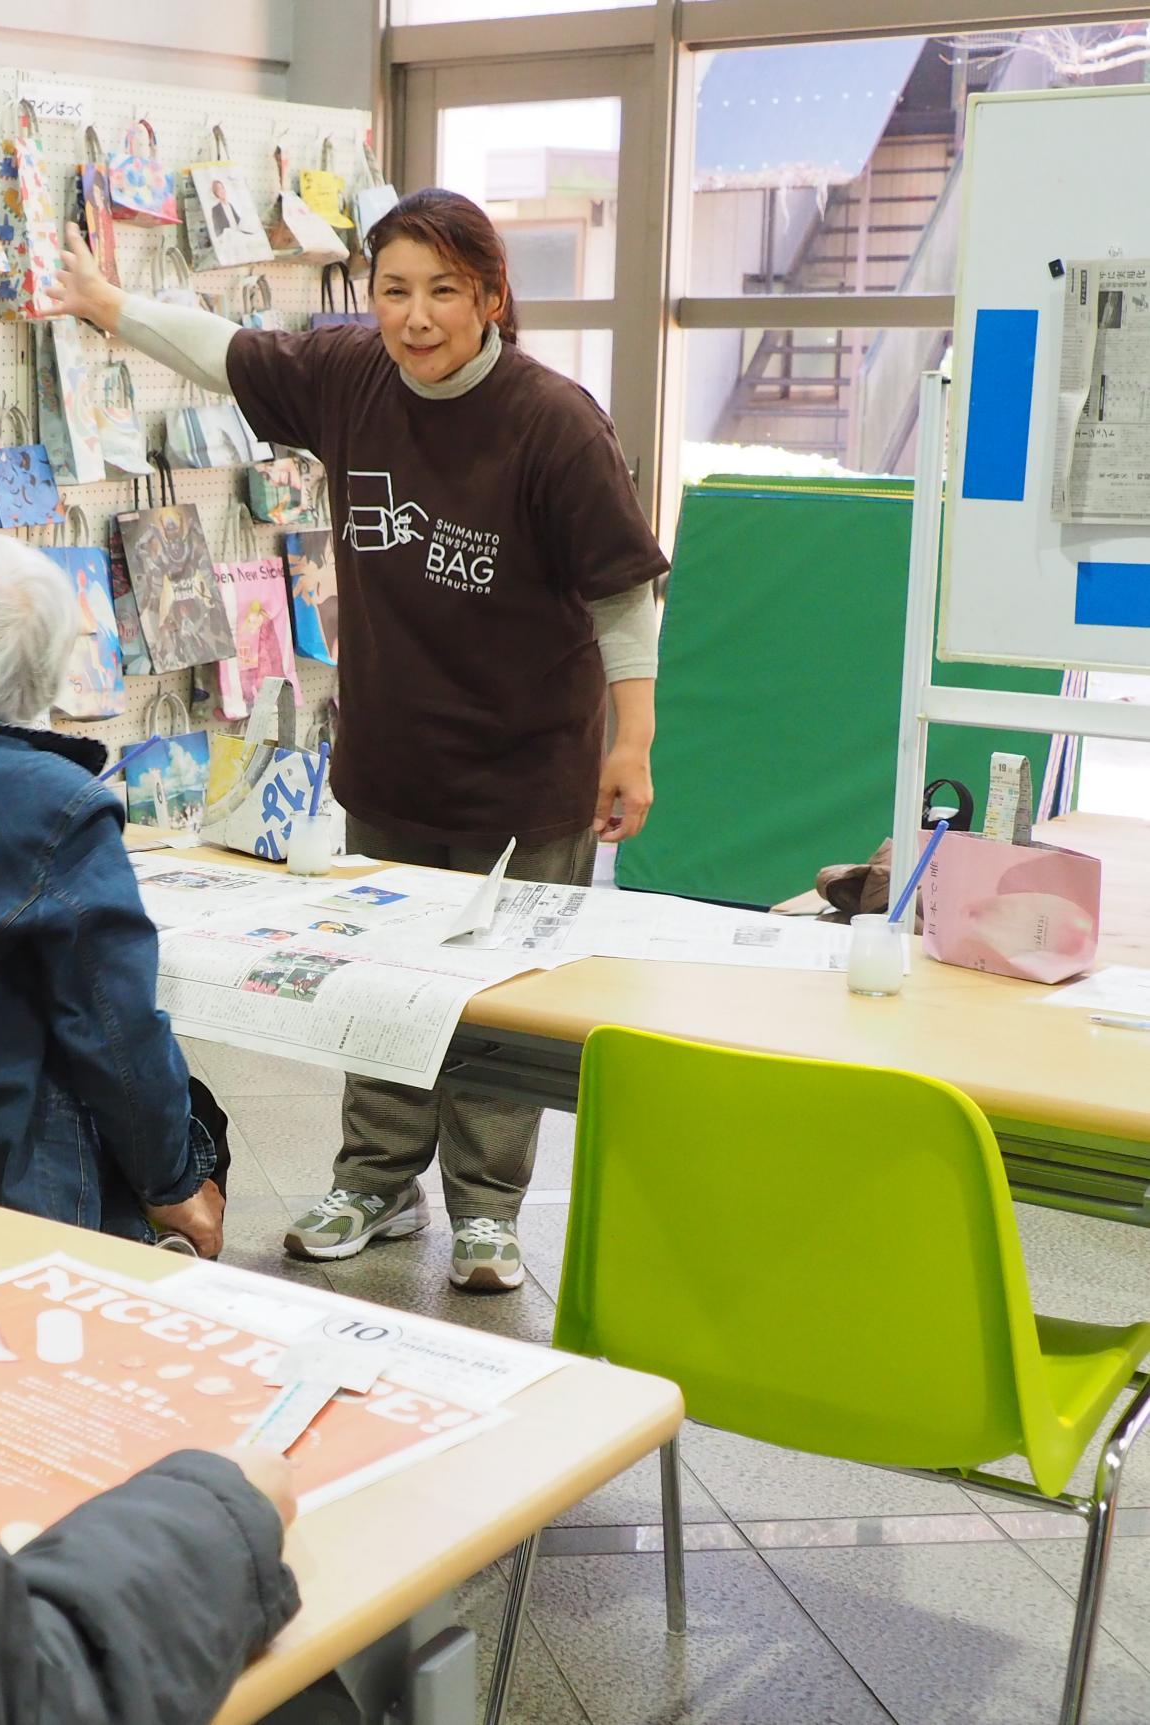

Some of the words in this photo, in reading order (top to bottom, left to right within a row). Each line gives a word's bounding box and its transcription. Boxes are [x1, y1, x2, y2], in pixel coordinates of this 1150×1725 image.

[432, 530, 498, 557] NEWSPAPER
[435, 518, 500, 545] SHIMANTO
[426, 542, 495, 585] BAG
[425, 571, 491, 595] INSTRUCTOR
[338, 1320, 389, 1342] 10
[13, 1265, 239, 1352] NICE!
[217, 1338, 476, 1434] RE!
